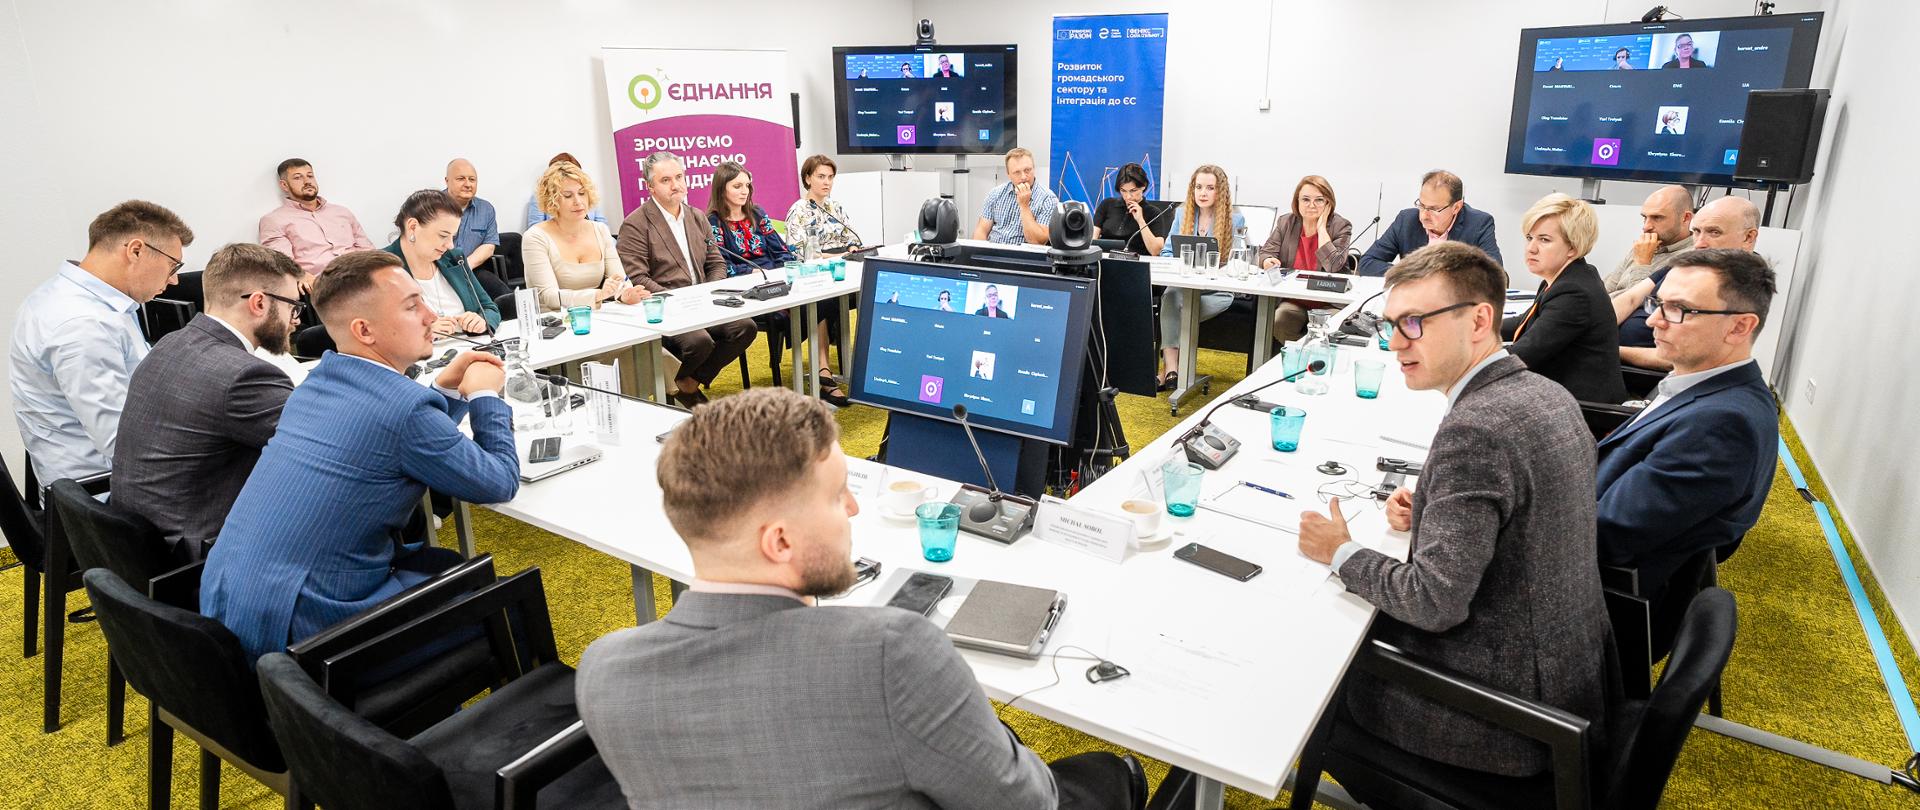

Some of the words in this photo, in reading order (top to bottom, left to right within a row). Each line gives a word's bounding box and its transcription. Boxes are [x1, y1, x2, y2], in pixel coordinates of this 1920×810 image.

[1057, 62, 1102, 70] Розвиток
[1057, 75, 1125, 83] громадського
[668, 83, 772, 101] ЄДНАННЯ
[1057, 87, 1095, 95] сектору
[1108, 98, 1121, 106] до
[1123, 97, 1136, 105] ЄС
[634, 135, 732, 151] ЗРОЩУЄМО
